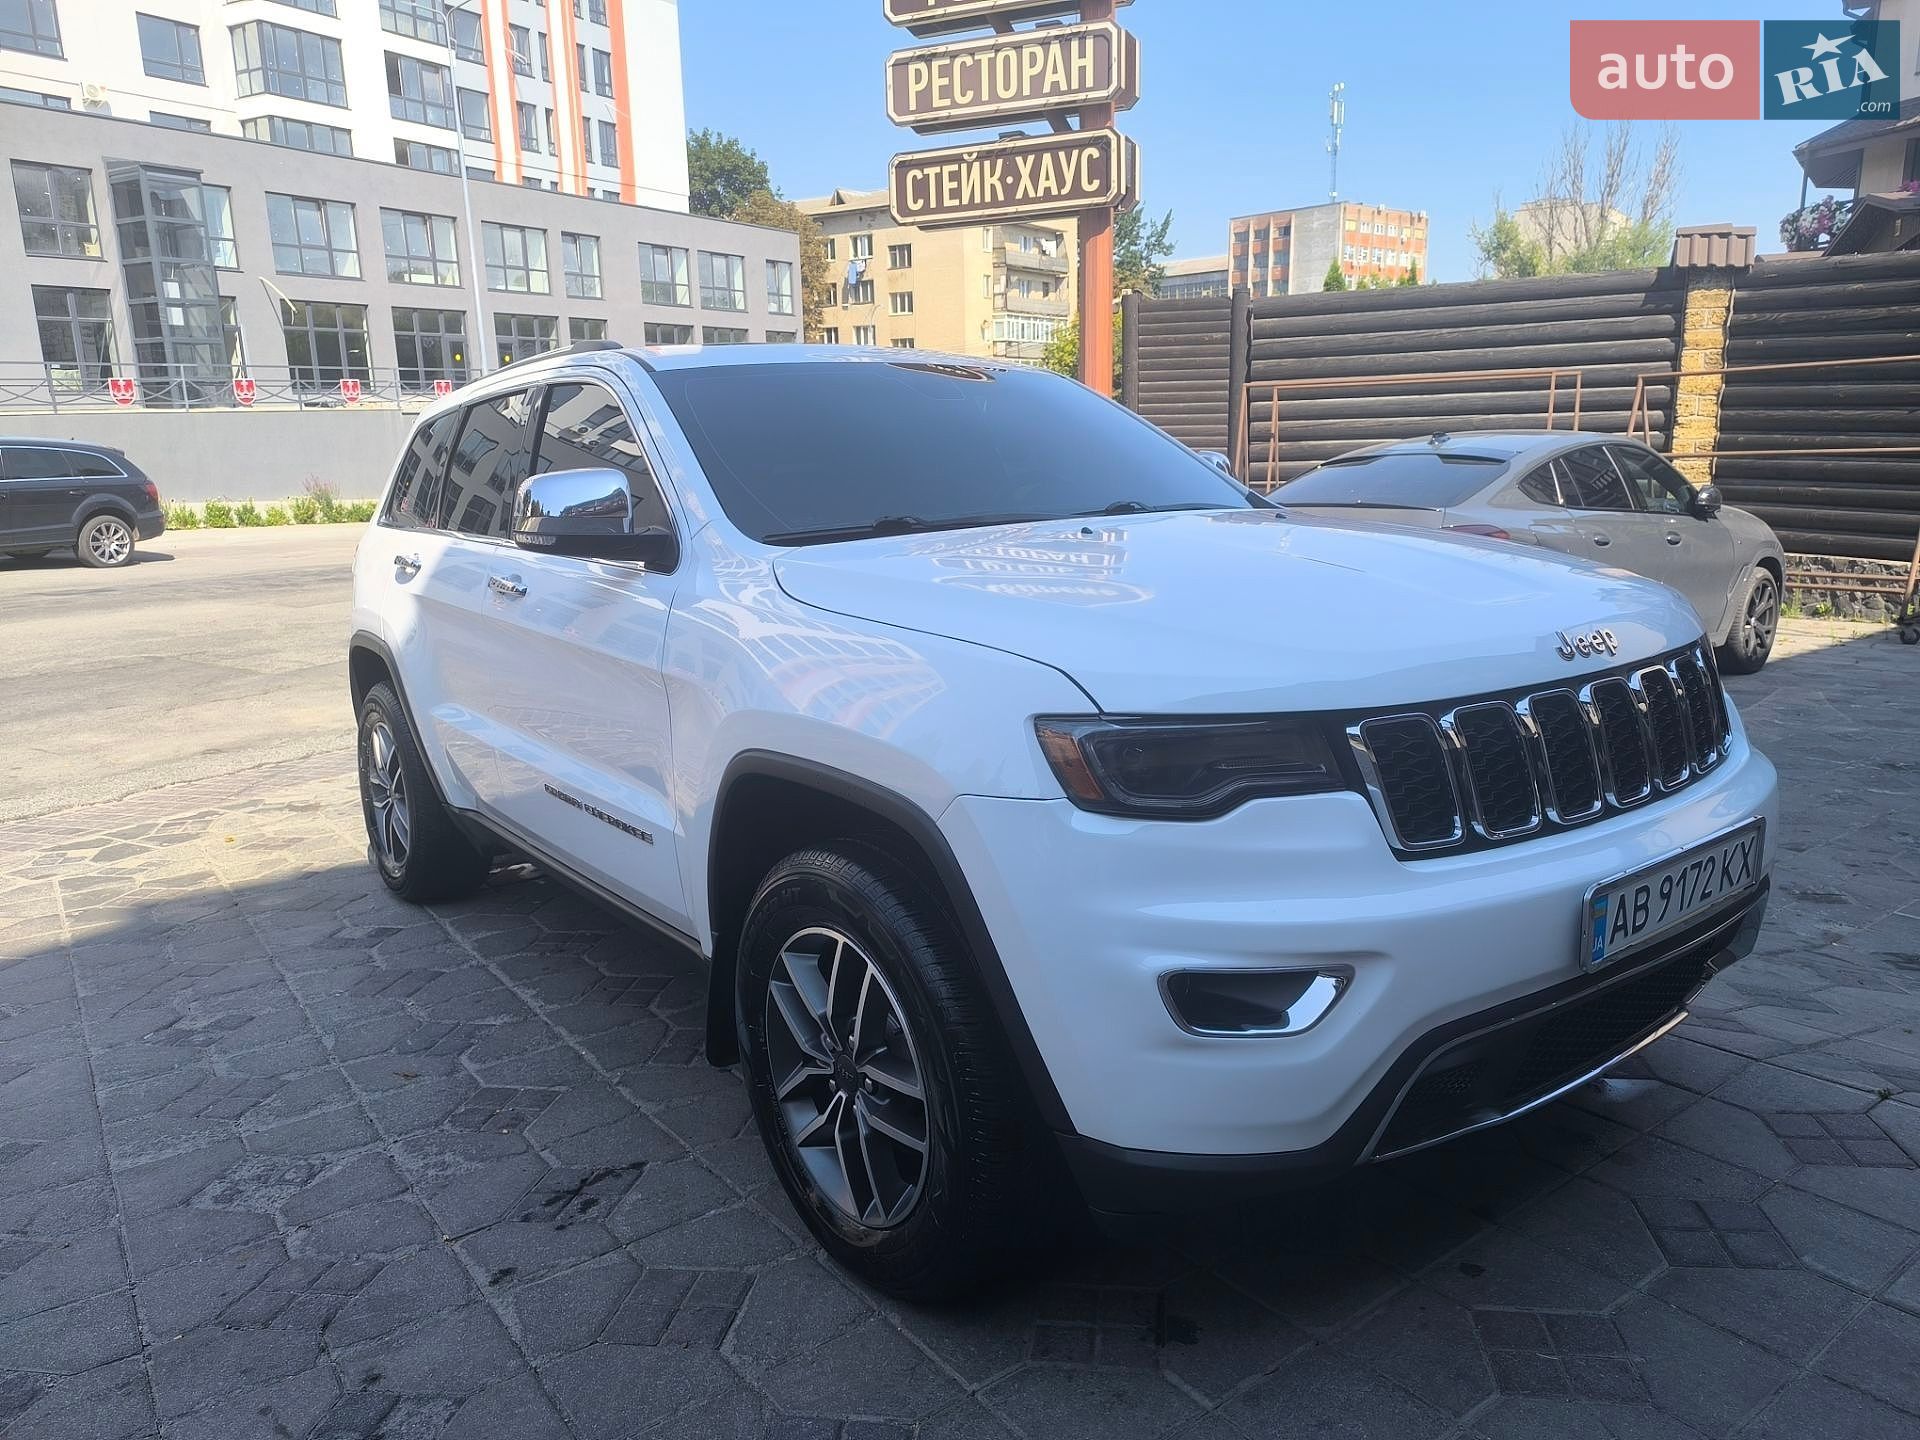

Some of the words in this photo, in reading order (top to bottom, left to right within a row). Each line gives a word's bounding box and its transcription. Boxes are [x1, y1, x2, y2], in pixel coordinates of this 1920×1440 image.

[907, 35, 1095, 111] РЕСТОРАН
[1554, 629, 1618, 661] Jeep
[1608, 884, 1651, 945] AB
[1656, 855, 1717, 923] 9172
[1719, 836, 1756, 892] KX
